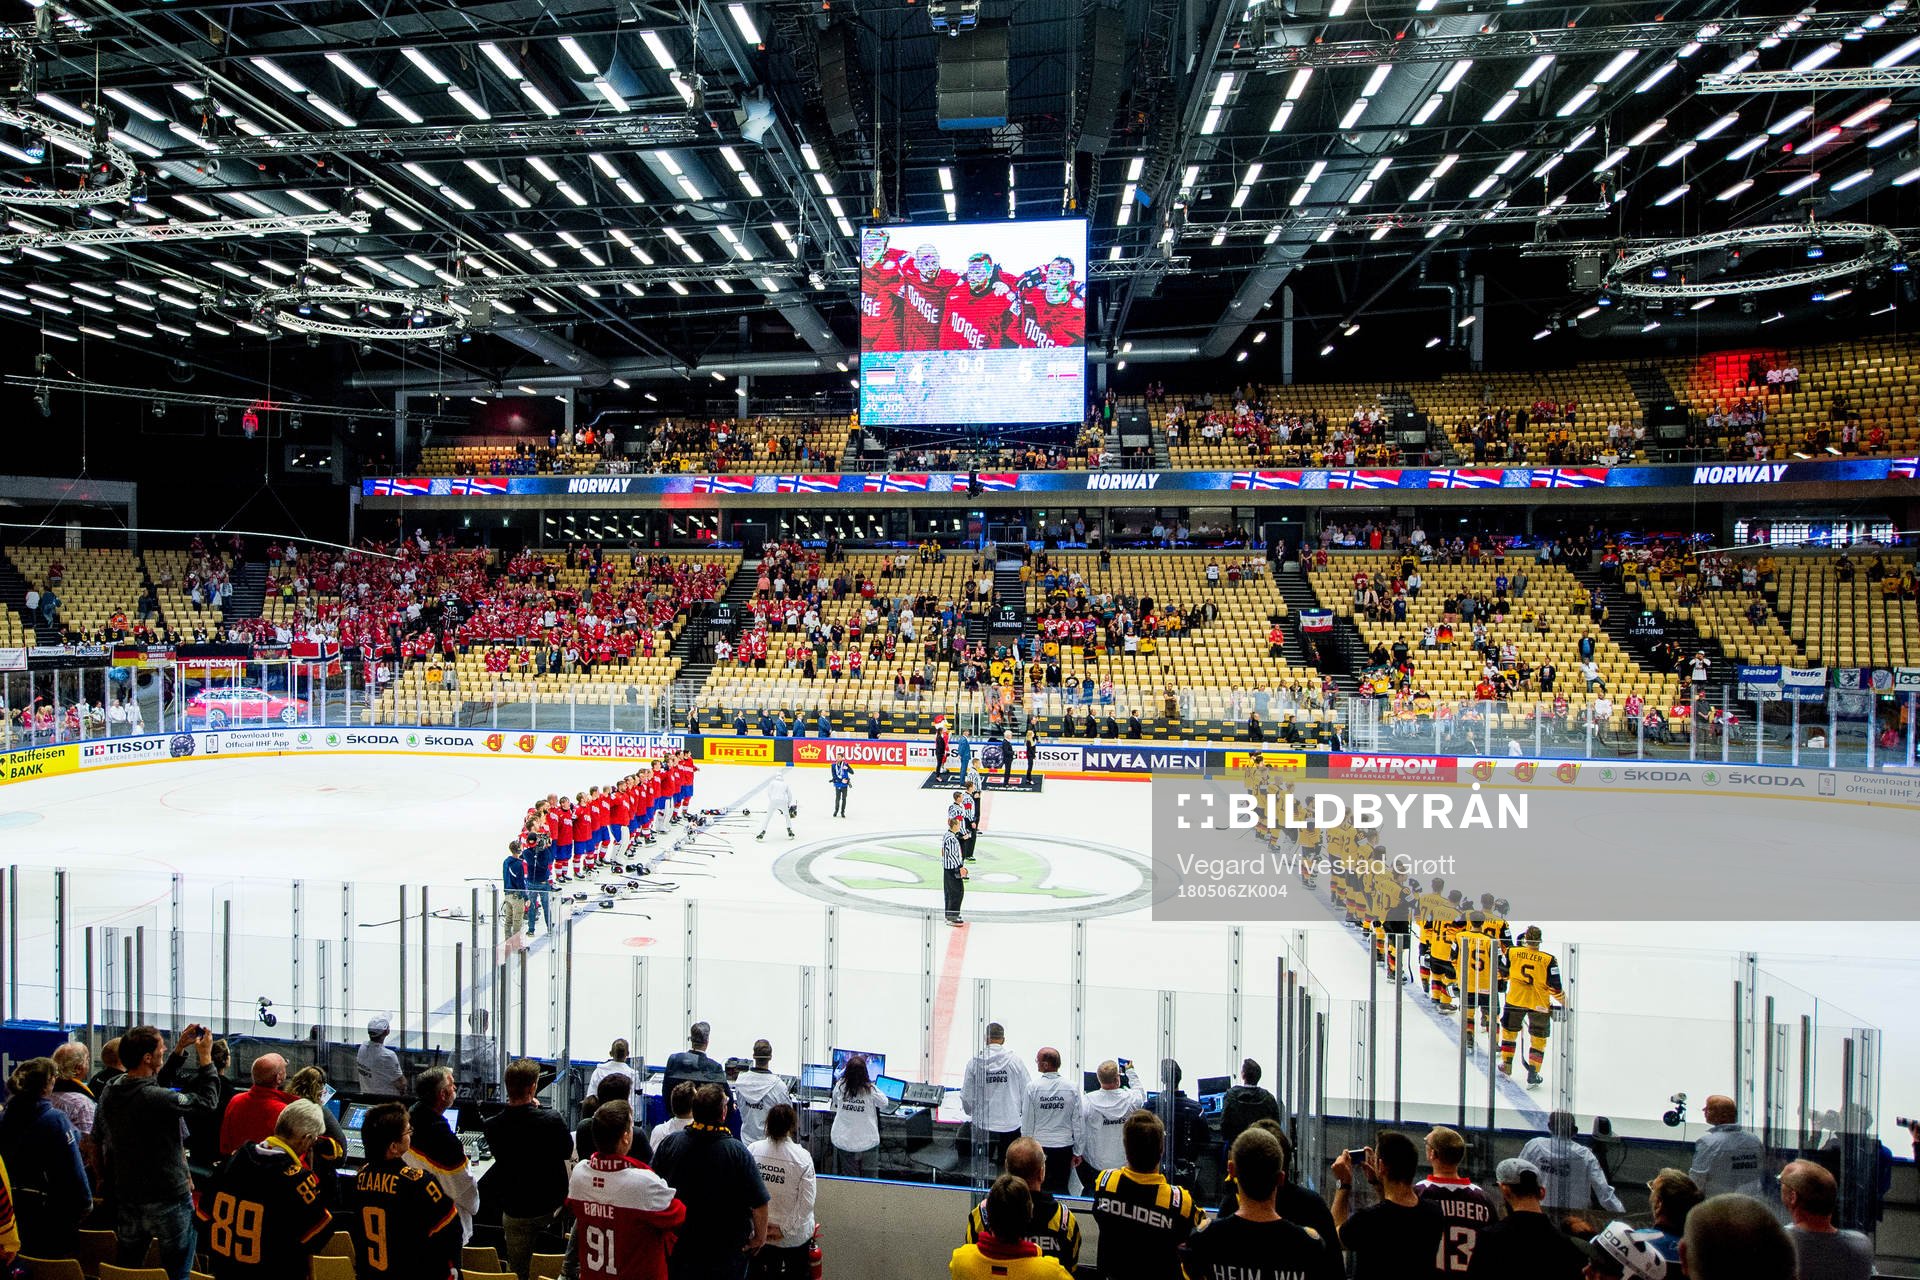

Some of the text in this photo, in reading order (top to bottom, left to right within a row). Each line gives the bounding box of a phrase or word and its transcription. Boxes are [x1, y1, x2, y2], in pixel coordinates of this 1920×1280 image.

[951, 312, 985, 349] NORGE
[1024, 318, 1063, 348] NORG
[1087, 473, 1160, 490] NORWAY
[1693, 464, 1788, 484] NORWAY
[568, 478, 631, 493] NORWAY
[718, 608, 730, 617] L11
[1000, 611, 1015, 620] L12
[189, 658, 238, 668] ZWICKAU
[230, 731, 270, 739] Download
[346, 733, 399, 744] ŠKODA
[424, 735, 474, 746] ŠKODA
[581, 736, 611, 746] LIQUI
[616, 736, 646, 747] LIQUI
[106, 740, 165, 754] TISSOT
[225, 740, 254, 748] Official
[273, 740, 290, 748] App
[581, 746, 611, 756] MOLY
[710, 742, 767, 757] PIRELLI
[10, 748, 65, 764] Raiffeisen
[616, 747, 646, 757] MOLY
[826, 743, 903, 762] KRUŠOVICE
[1085, 752, 1148, 768] NIVEA
[1151, 754, 1200, 769] MEN
[1350, 757, 1437, 775] PATRON
[11, 763, 43, 778] BANK
[1624, 769, 1692, 782] ŠKODA
[1728, 771, 1805, 788] ŠKODA
[1853, 774, 1910, 787] Download
[1845, 784, 1886, 795] Official
[1516, 952, 1543, 962] HOLZER
[1521, 964, 1534, 985] 5
[842, 1104, 865, 1112] HEROES
[1040, 1102, 1064, 1110] HEROES
[426, 1181, 442, 1202] 9
[1099, 1198, 1173, 1230] BOLIDEN
[211, 1191, 264, 1264] 89
[363, 1207, 388, 1271] 9
[587, 1225, 617, 1275] 91
[1213, 1264, 1261, 1280] HEIM
